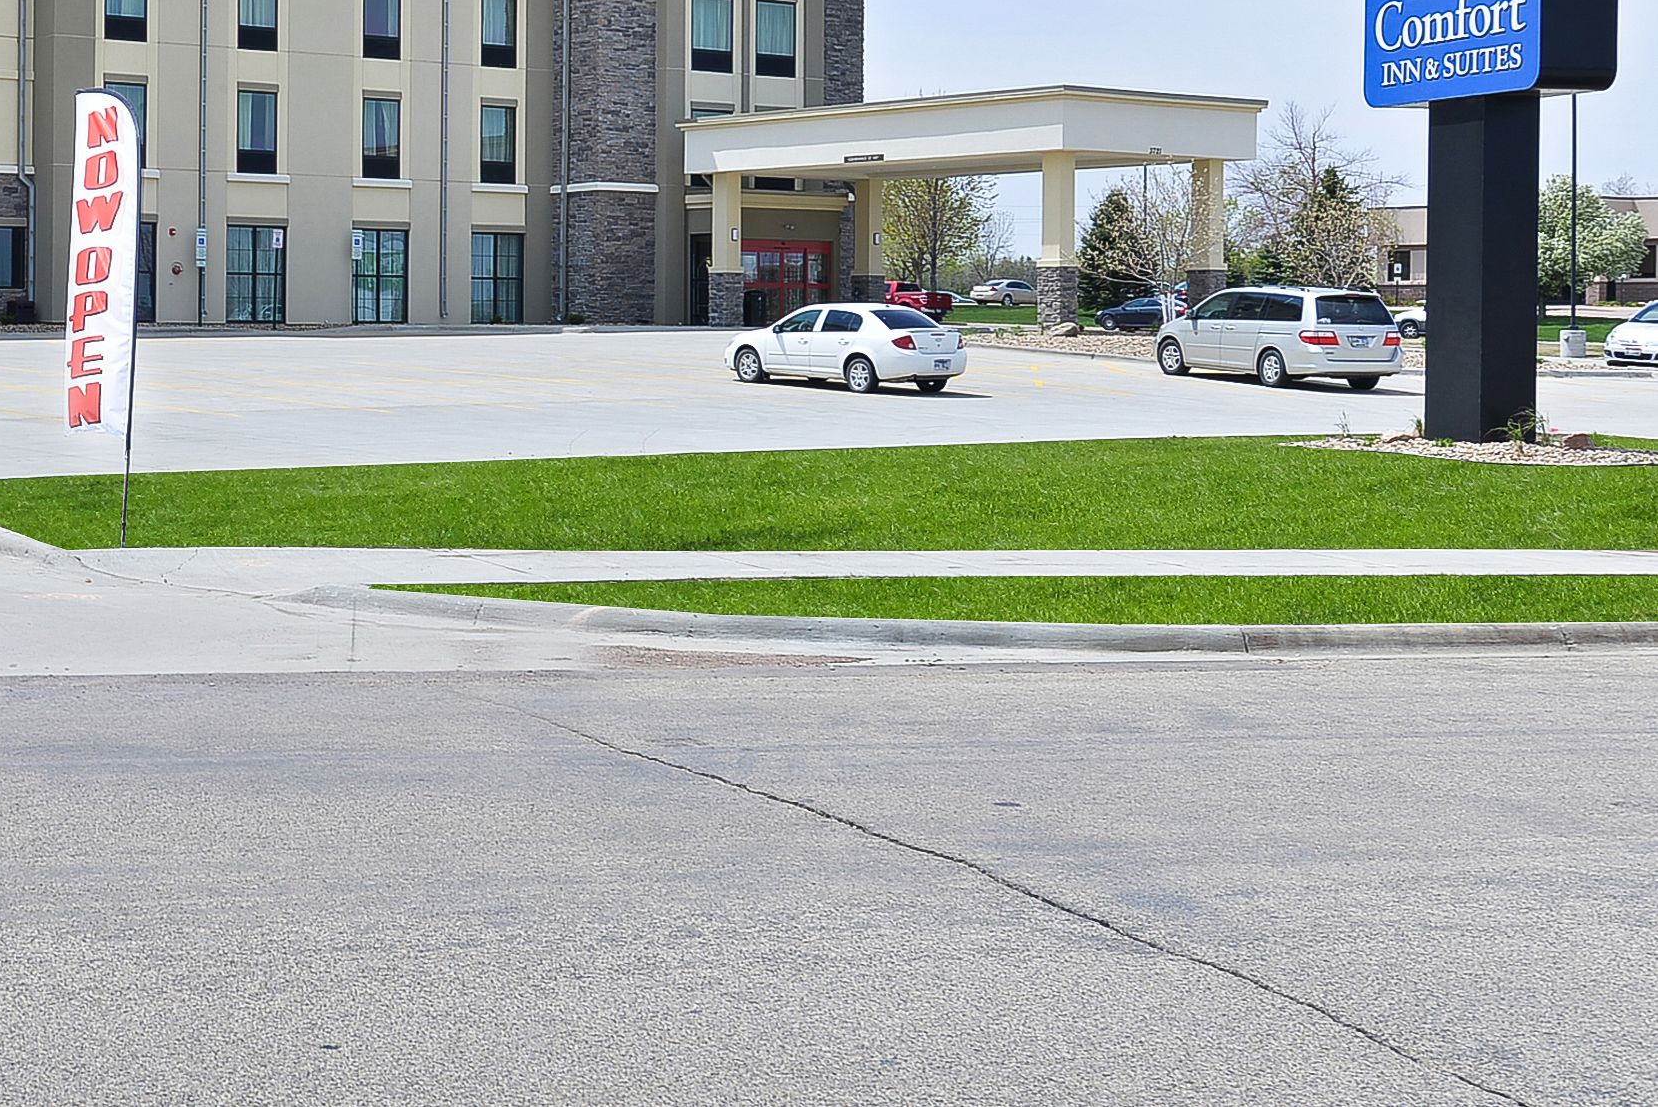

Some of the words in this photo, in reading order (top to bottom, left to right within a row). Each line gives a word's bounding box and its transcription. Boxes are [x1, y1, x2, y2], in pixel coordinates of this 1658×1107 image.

[1381, 57, 1423, 87] INN
[1424, 58, 1440, 80] &
[1444, 43, 1523, 78] SUITES
[76, 106, 123, 234] NOW
[67, 246, 112, 429] OPEN
